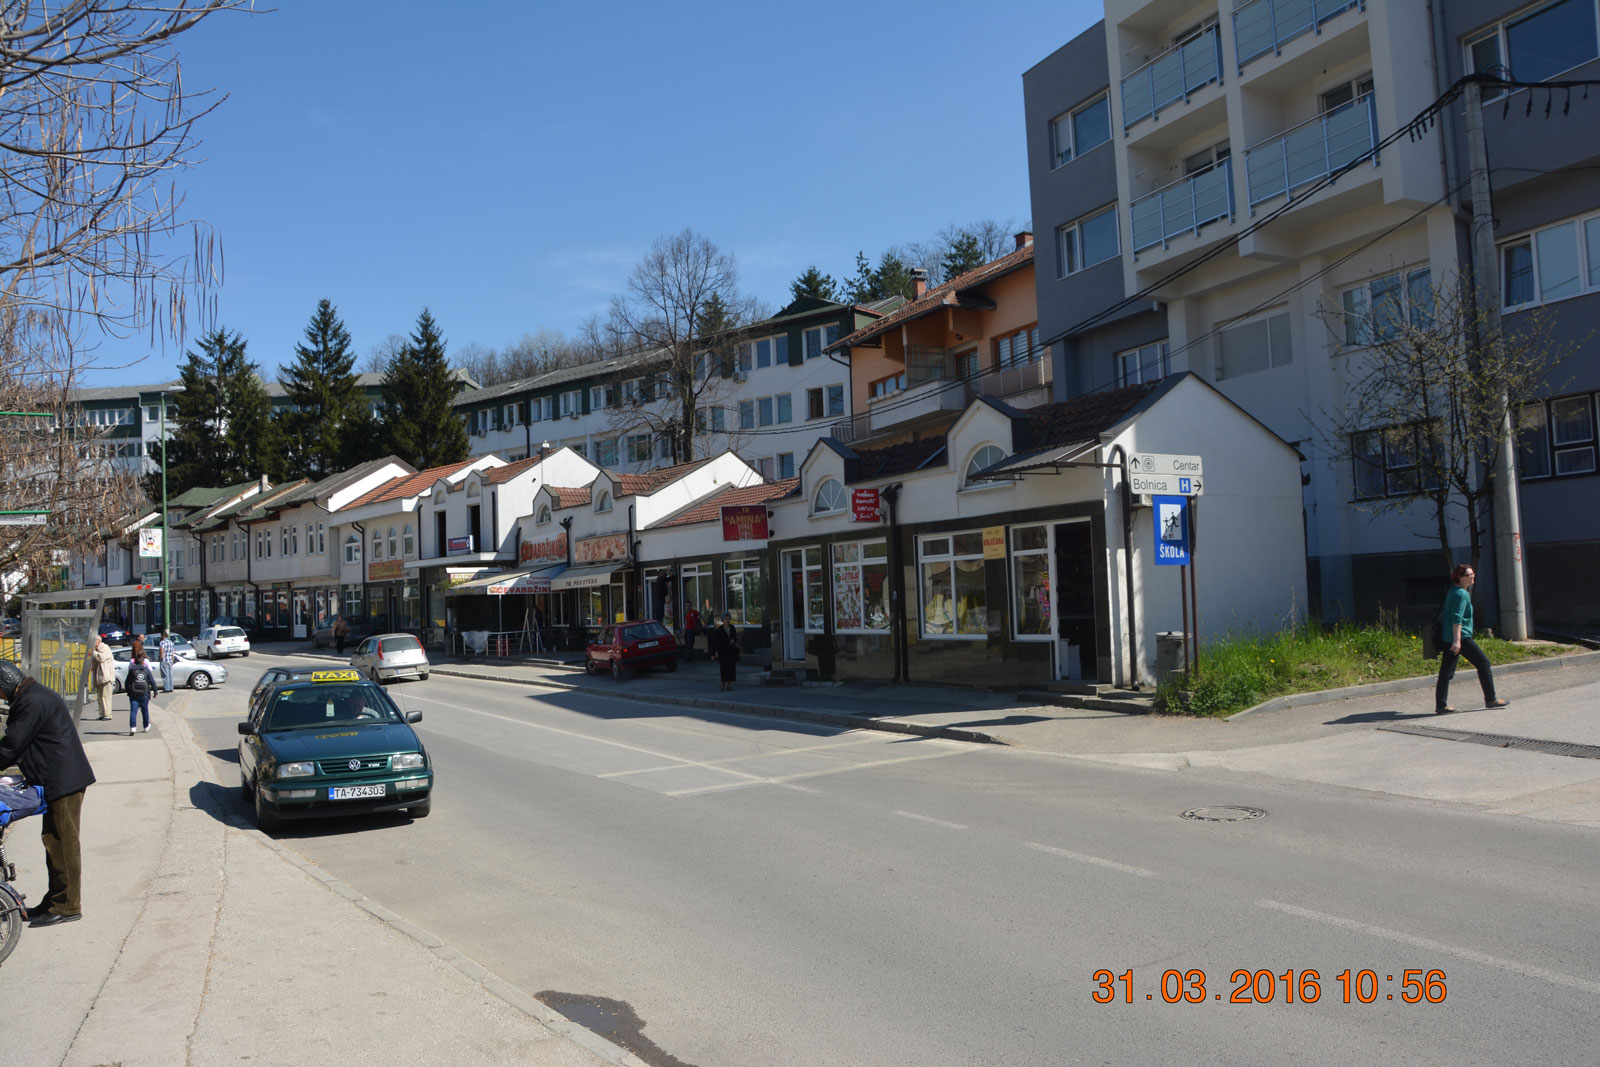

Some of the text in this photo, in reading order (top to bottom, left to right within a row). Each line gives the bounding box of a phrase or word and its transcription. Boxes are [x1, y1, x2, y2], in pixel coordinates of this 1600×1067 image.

[1173, 459, 1200, 471] Centar
[1133, 478, 1190, 491] Bolnica H
[1159, 543, 1185, 558] ŠKOLA
[316, 671, 356, 679] TAXI
[335, 785, 385, 799] TA-734303
